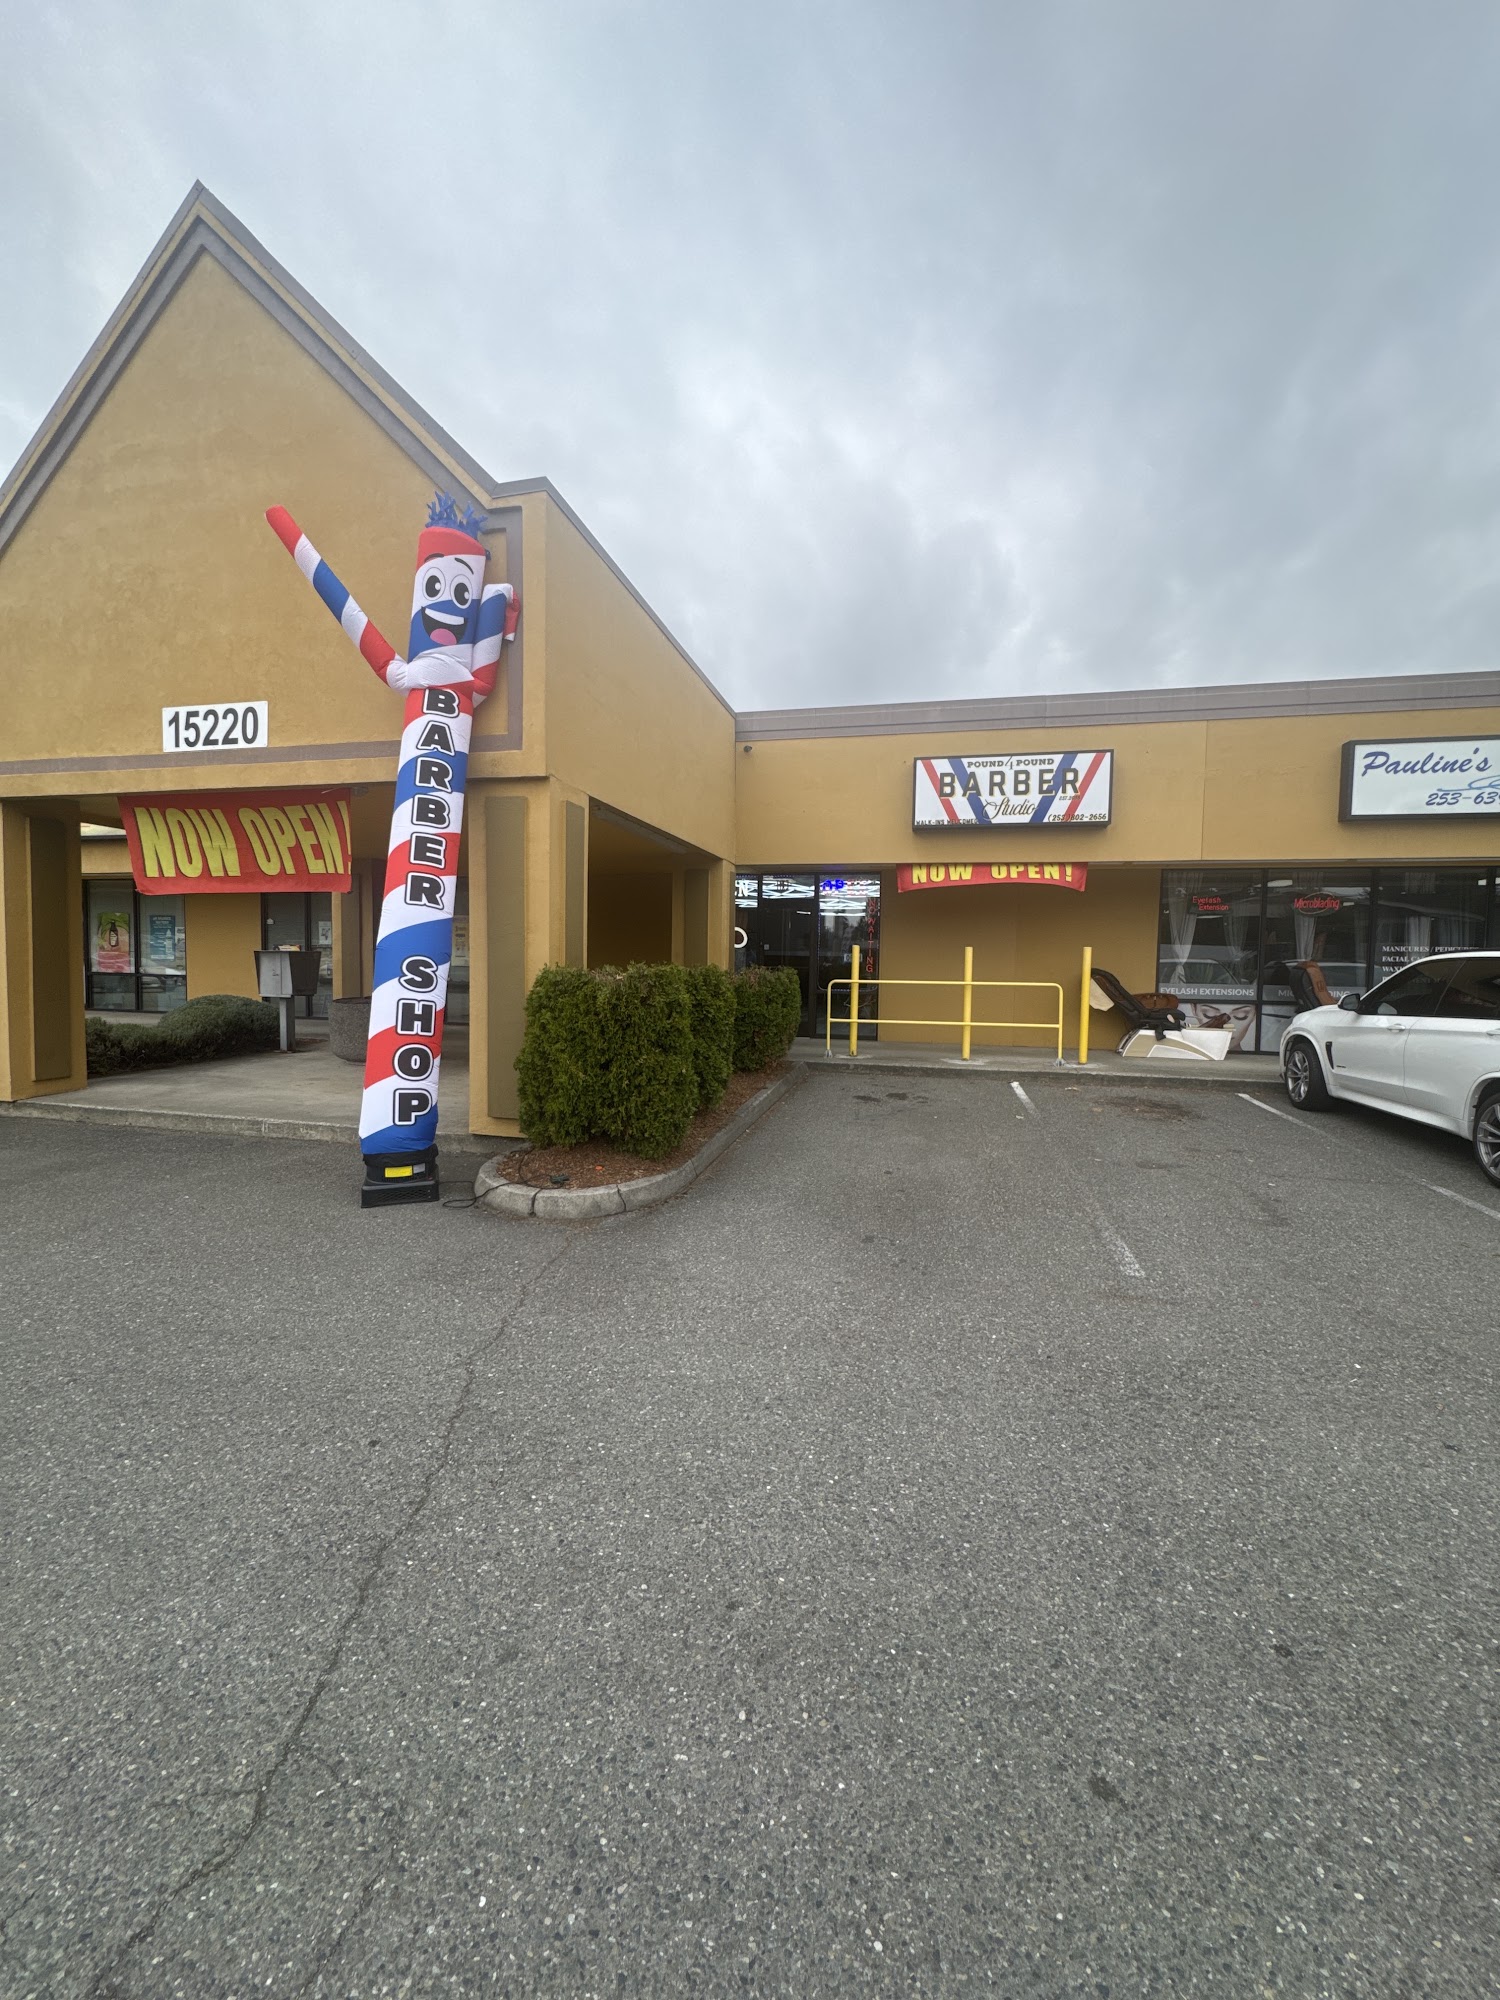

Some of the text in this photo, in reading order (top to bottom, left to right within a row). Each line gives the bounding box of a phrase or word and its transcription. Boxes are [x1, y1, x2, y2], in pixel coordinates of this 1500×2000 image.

[168, 706, 259, 748] 15220
[967, 760, 1004, 768] POUND
[1016, 758, 1054, 766] POUND
[1361, 747, 1493, 777] Pauline's
[939, 768, 1080, 798] BARBER
[983, 796, 1038, 822] Studio
[1425, 791, 1500, 806] 253-63
[134, 800, 352, 878] NOW OPEN!
[911, 864, 1073, 884] NOW OPEN!
[392, 687, 460, 1126] BARBER SHOP
[1192, 896, 1222, 904] Eyelash
[1198, 903, 1229, 911] Extension
[1293, 897, 1341, 911] Microblading
[866, 918, 876, 973] WAITING
[1160, 987, 1254, 997] EYELASH EXTENSIONS
